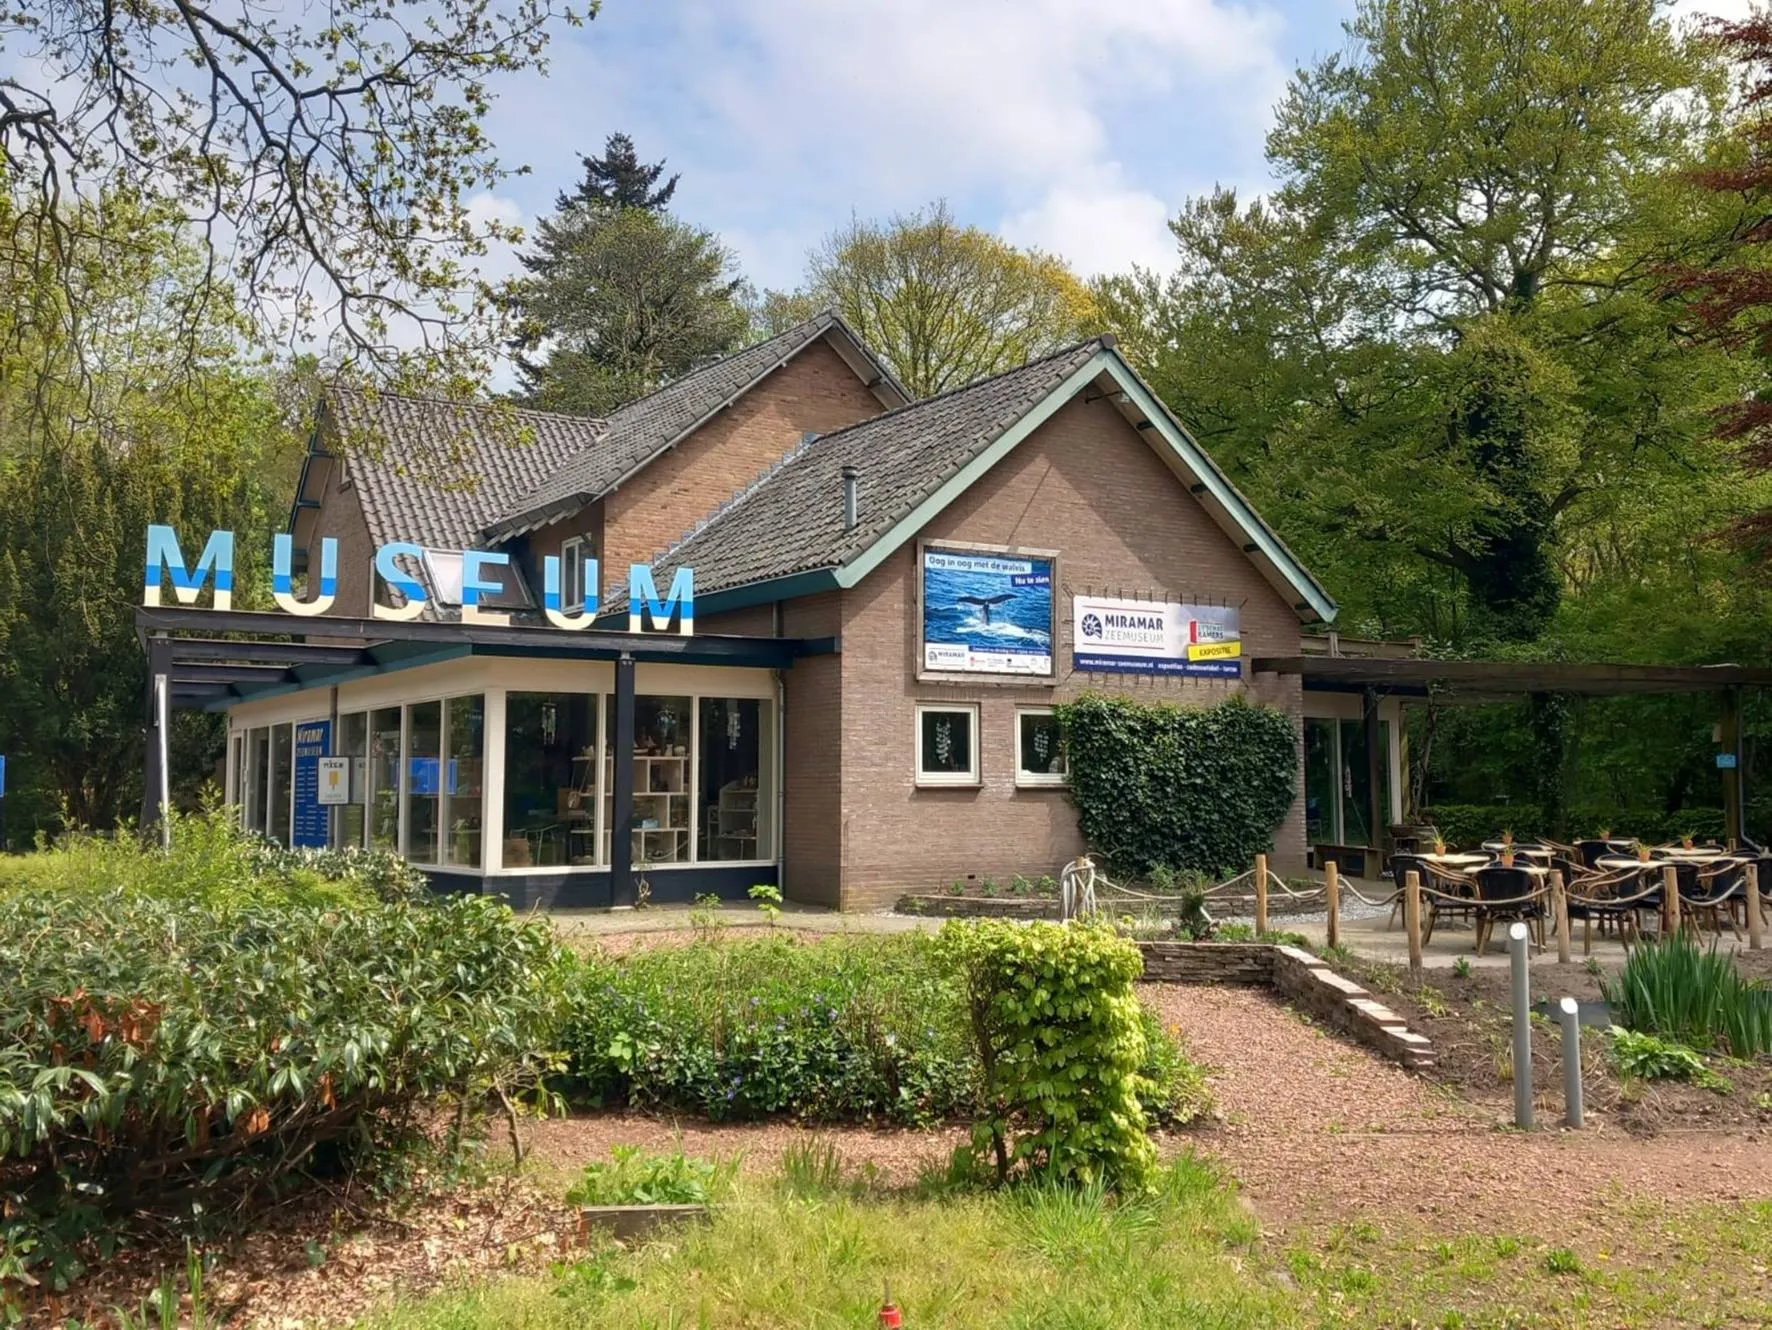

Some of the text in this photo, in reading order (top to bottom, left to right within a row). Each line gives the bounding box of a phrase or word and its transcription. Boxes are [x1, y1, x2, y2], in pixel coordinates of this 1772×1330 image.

[929, 556, 1026, 572] Oog in oog met de walvis
[144, 524, 693, 636] MUSEUM
[1104, 614, 1164, 631] MIRAMAR
[1104, 630, 1164, 643] ZEEMUSEUM
[1199, 646, 1232, 656] EXPOSITIE
